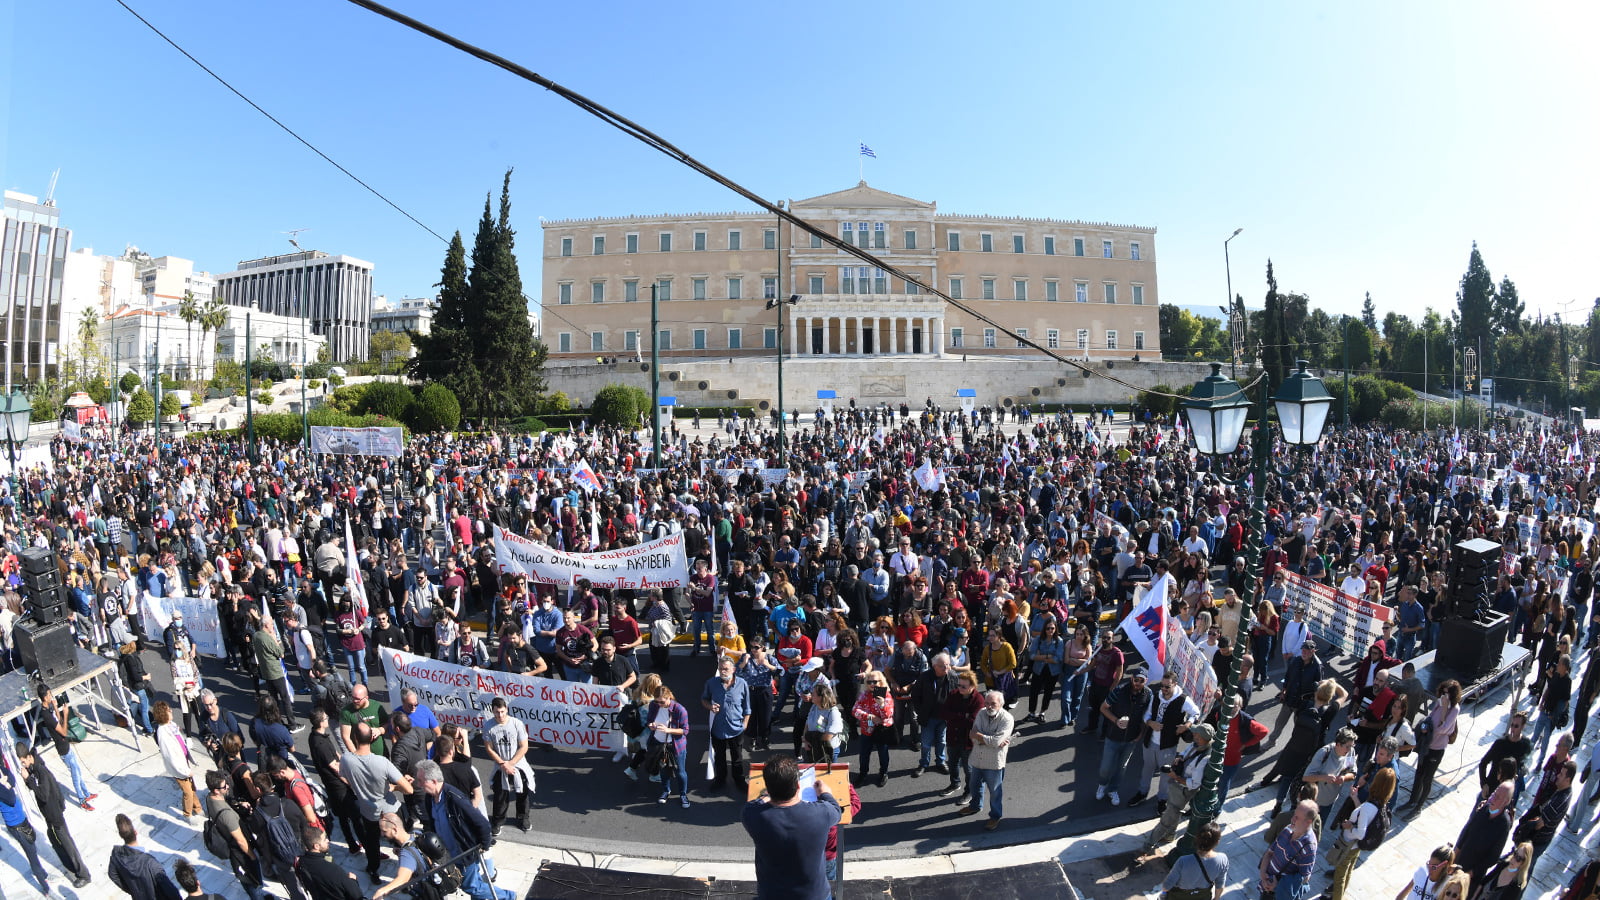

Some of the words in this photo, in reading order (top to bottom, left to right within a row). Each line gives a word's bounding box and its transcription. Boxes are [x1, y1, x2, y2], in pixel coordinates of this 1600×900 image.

[626, 553, 671, 571] ΑΚΡΙΒΕΙΑ
[392, 653, 471, 687] Ουσιαστικές
[541, 685, 568, 705] για
[572, 684, 621, 709] όλους
